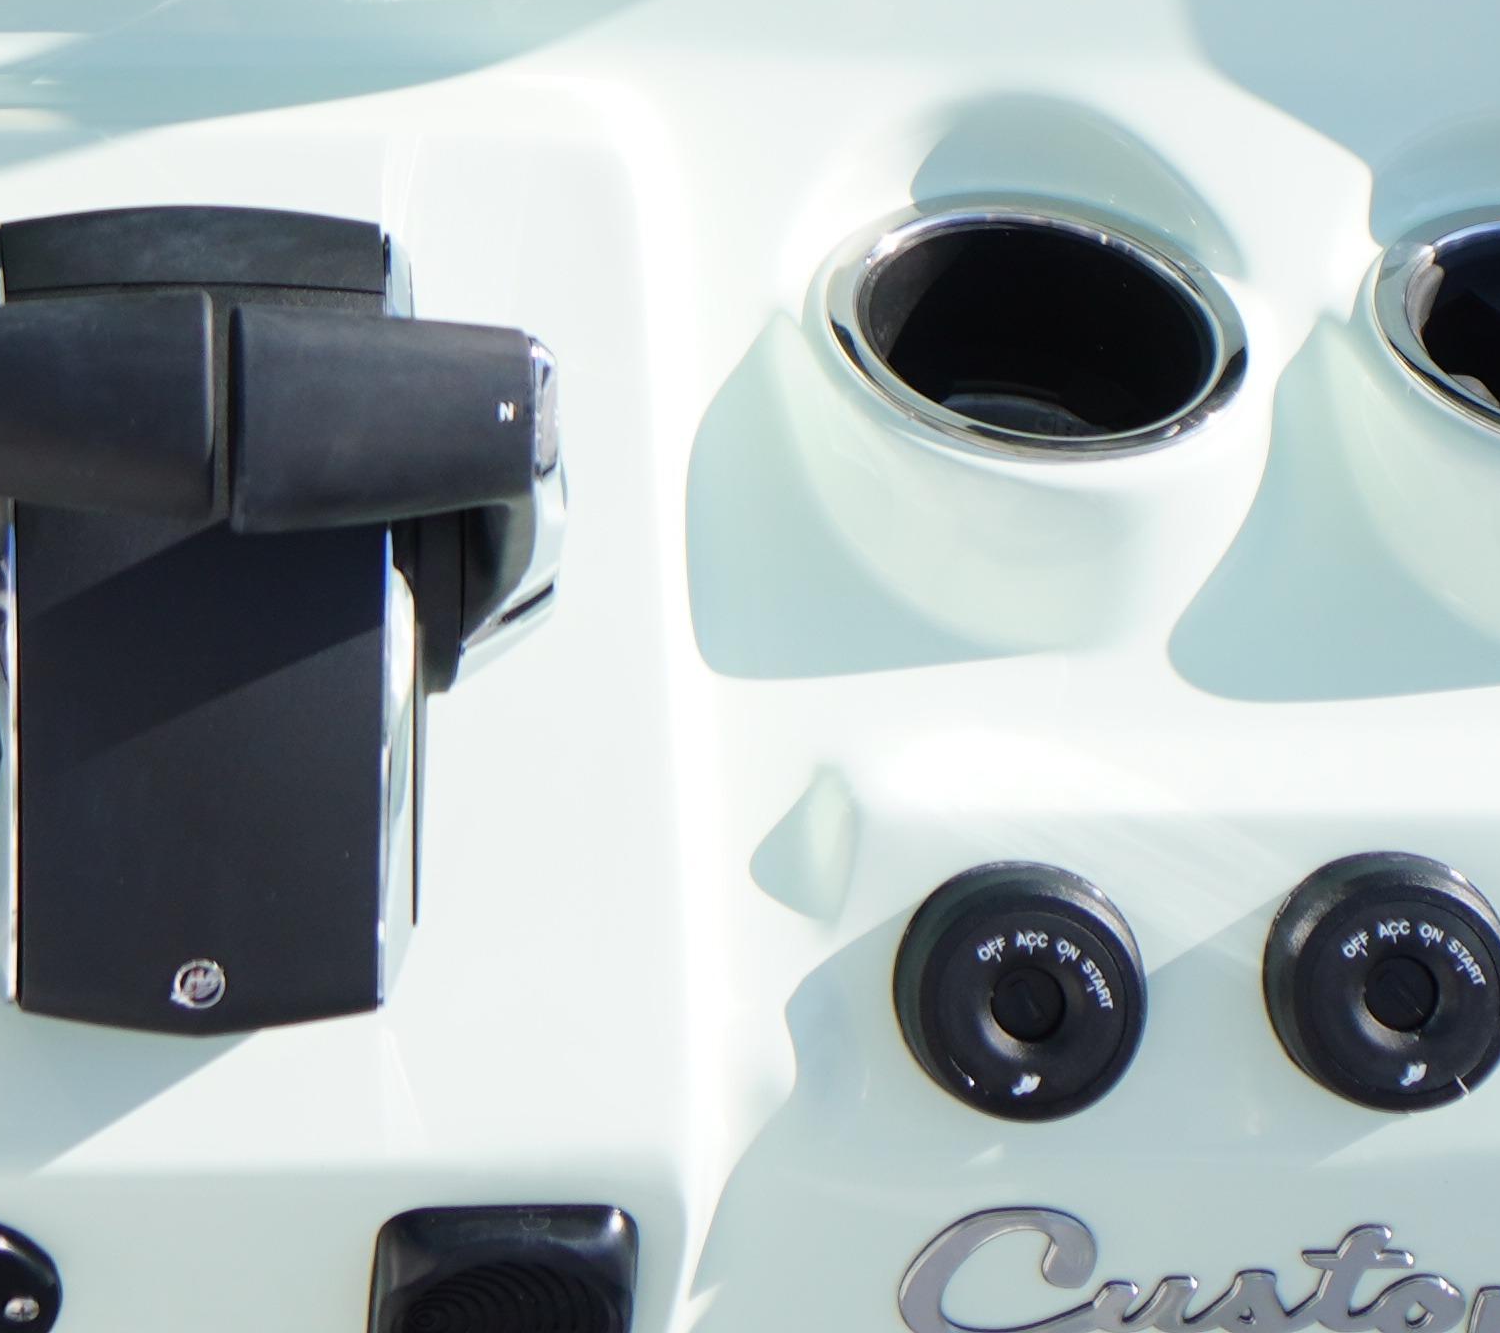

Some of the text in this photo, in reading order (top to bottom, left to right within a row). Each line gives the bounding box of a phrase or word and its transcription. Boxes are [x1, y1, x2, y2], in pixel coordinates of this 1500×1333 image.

[498, 400, 515, 423] N
[977, 930, 1114, 1009] OFF ACC ON START
[1342, 919, 1487, 985] OFF ACC ON START
